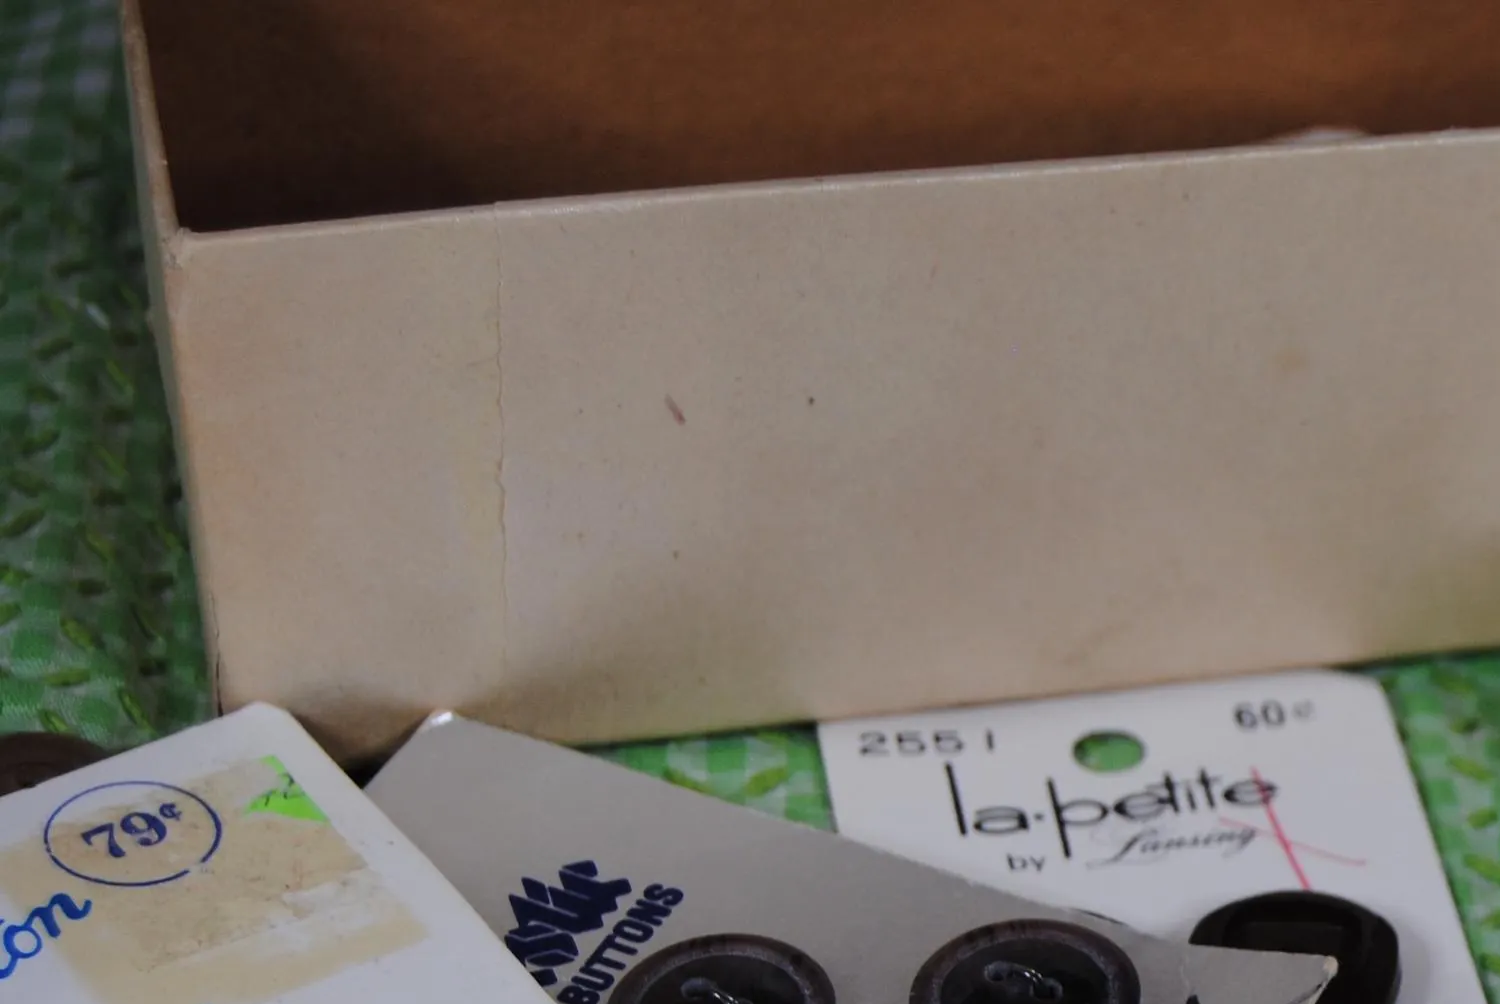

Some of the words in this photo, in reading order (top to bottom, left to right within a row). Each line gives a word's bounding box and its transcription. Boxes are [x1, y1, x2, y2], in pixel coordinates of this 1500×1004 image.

[858, 727, 995, 758] 2551
[80, 802, 183, 859] 79¢
[1007, 853, 1046, 873] by
